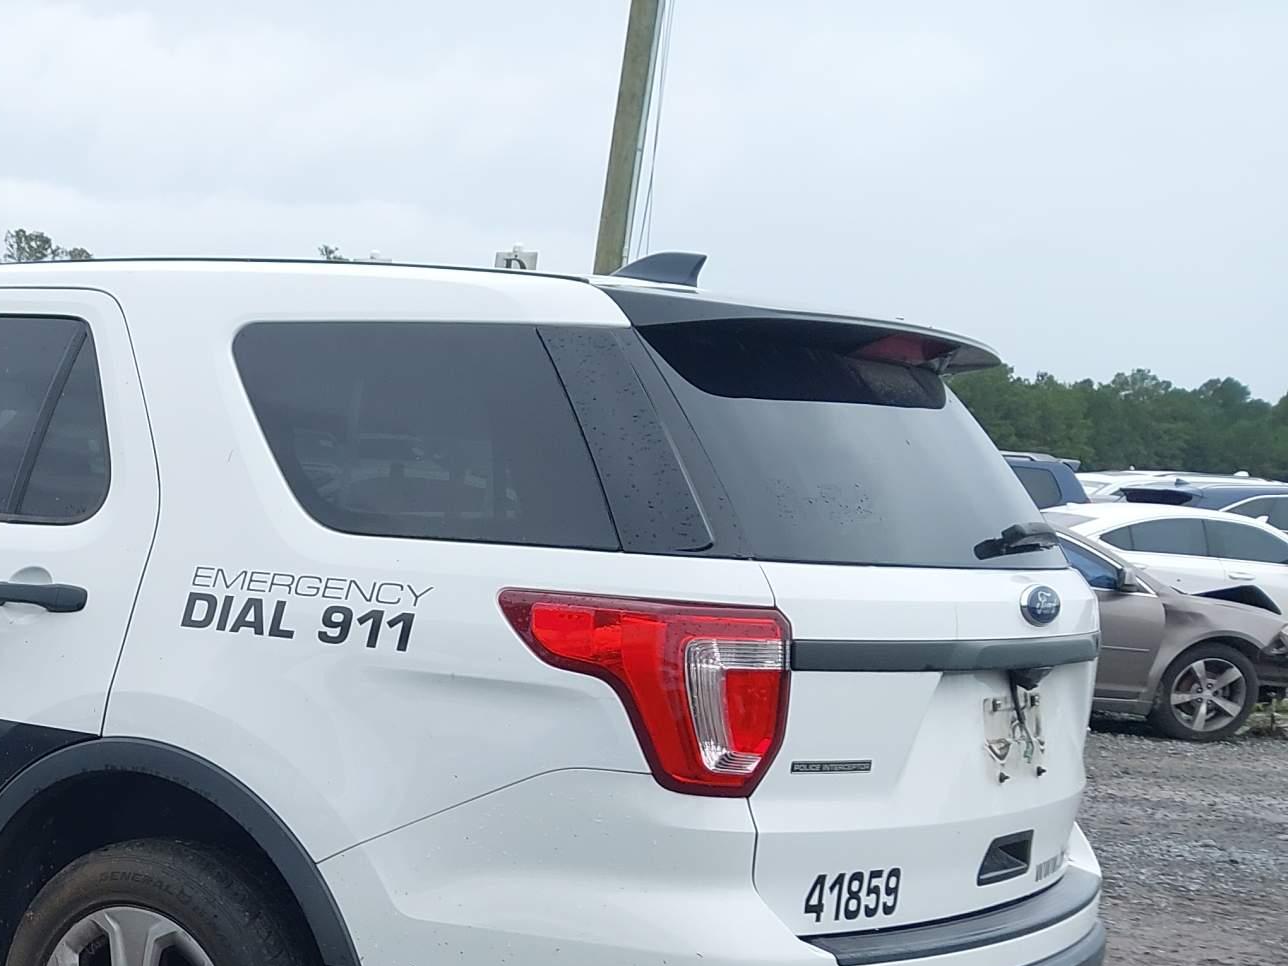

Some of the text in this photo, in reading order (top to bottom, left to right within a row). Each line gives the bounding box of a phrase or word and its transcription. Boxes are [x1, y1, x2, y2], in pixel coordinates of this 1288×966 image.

[191, 566, 435, 607] EMERGENCY
[180, 591, 416, 652] DIAL 911
[793, 763, 821, 771] POLICE
[804, 867, 901, 922] 41859
